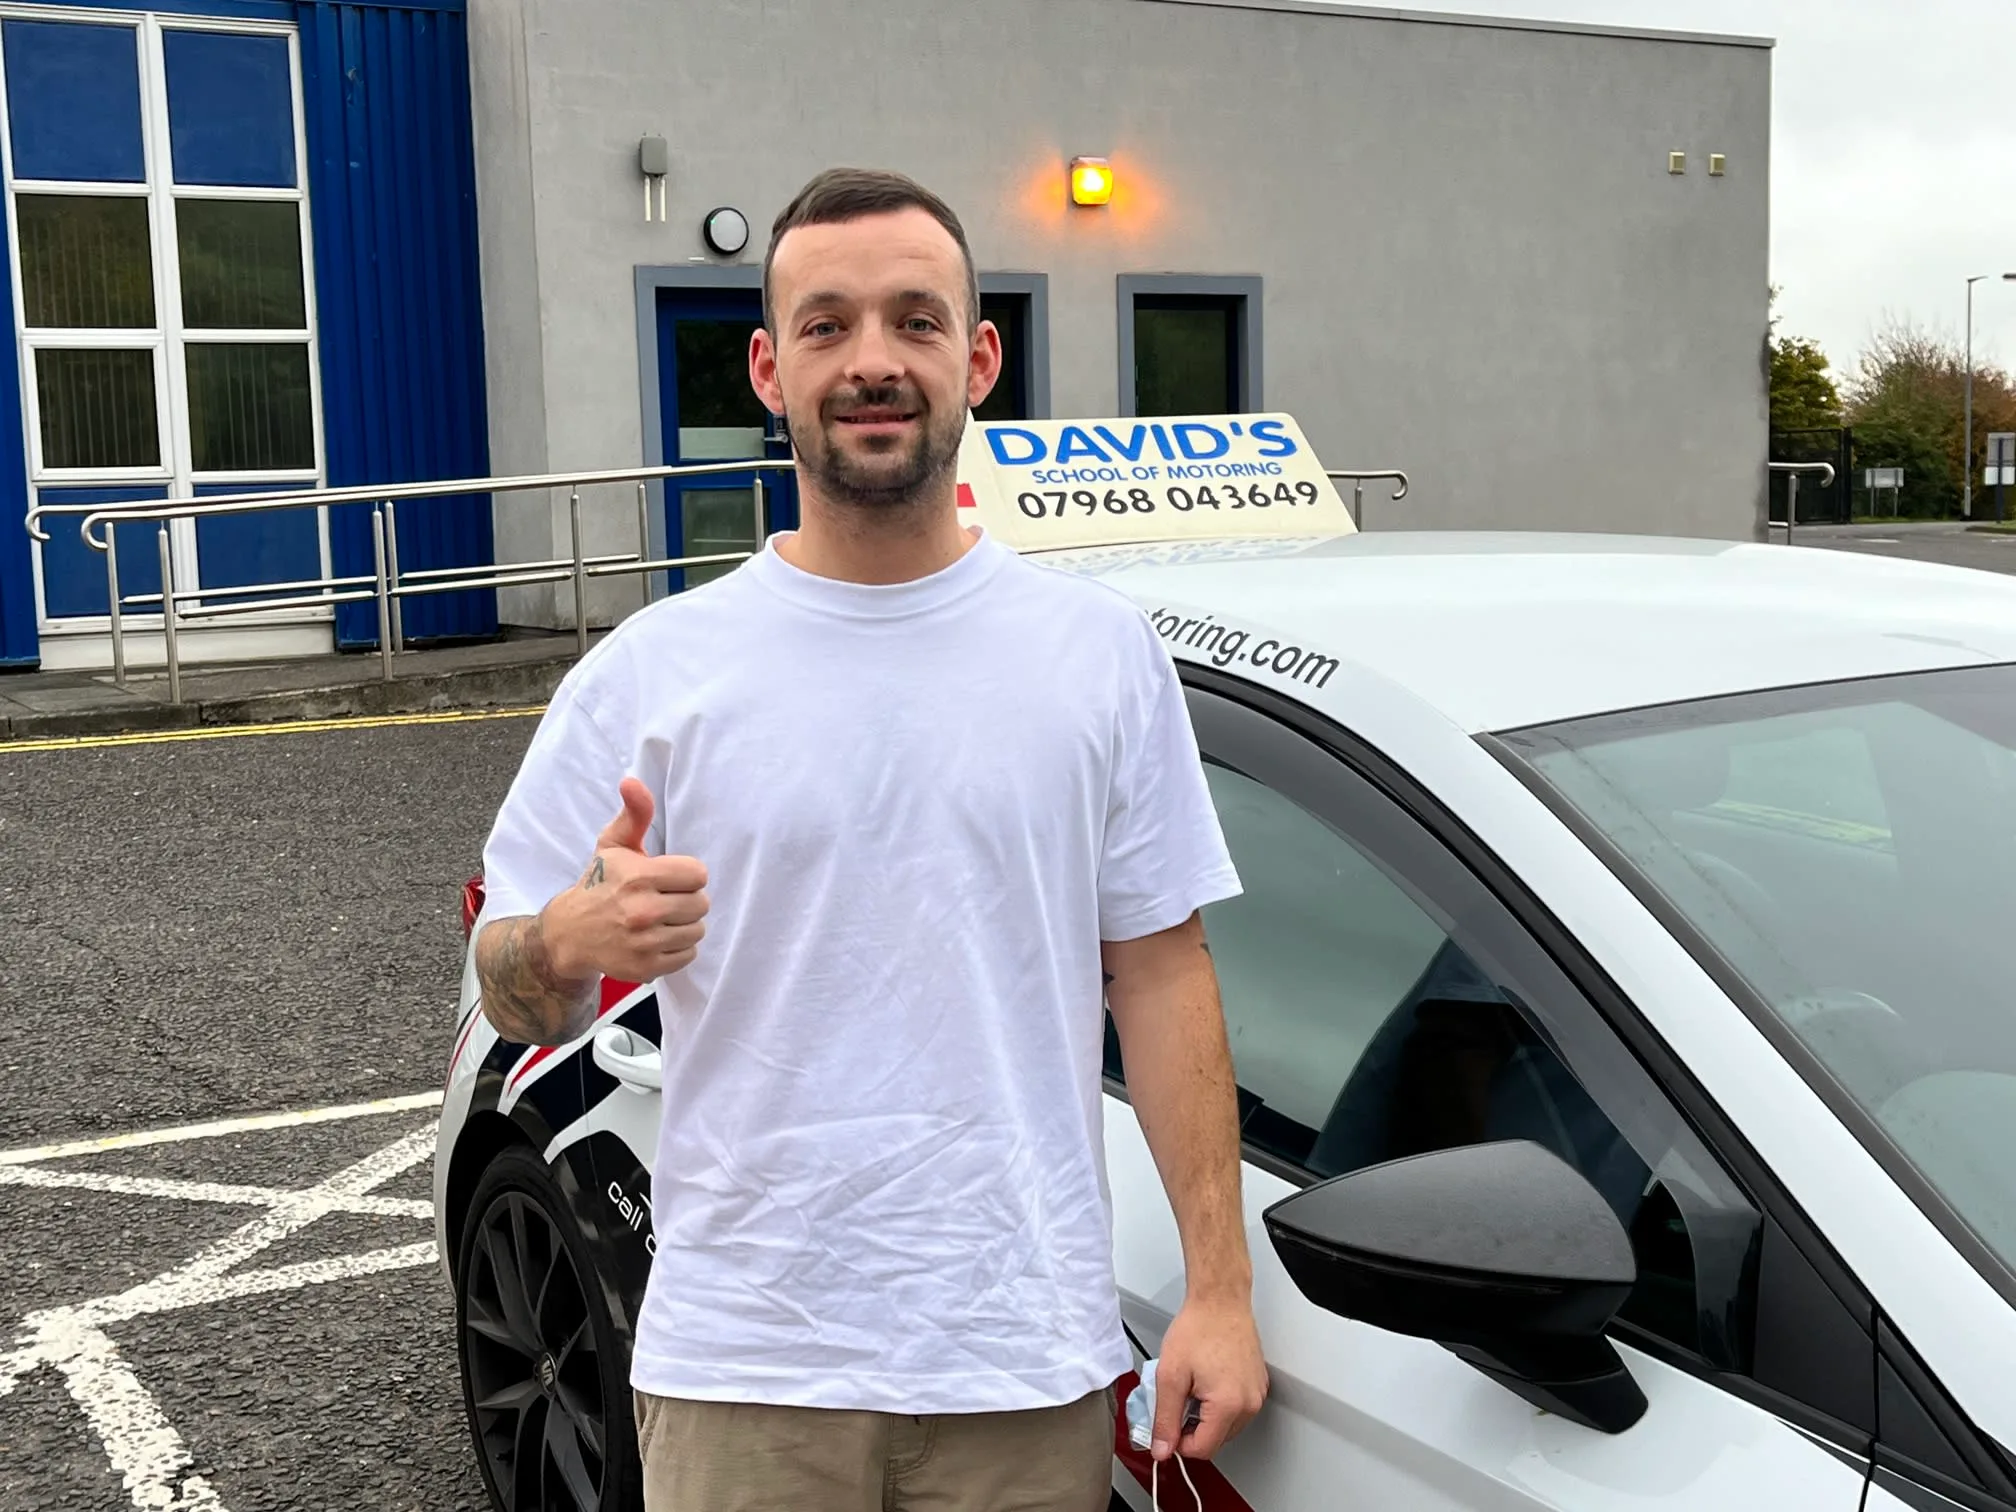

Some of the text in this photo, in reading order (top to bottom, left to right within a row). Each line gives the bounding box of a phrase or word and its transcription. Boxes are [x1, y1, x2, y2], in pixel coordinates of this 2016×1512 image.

[984, 420, 1298, 465] DAVID'S
[1032, 461, 1283, 484] SCHOOL OF MOTORING
[1017, 480, 1319, 519] 07968 043649
[1145, 607, 1340, 689] toring.com
[608, 1181, 644, 1232] call
